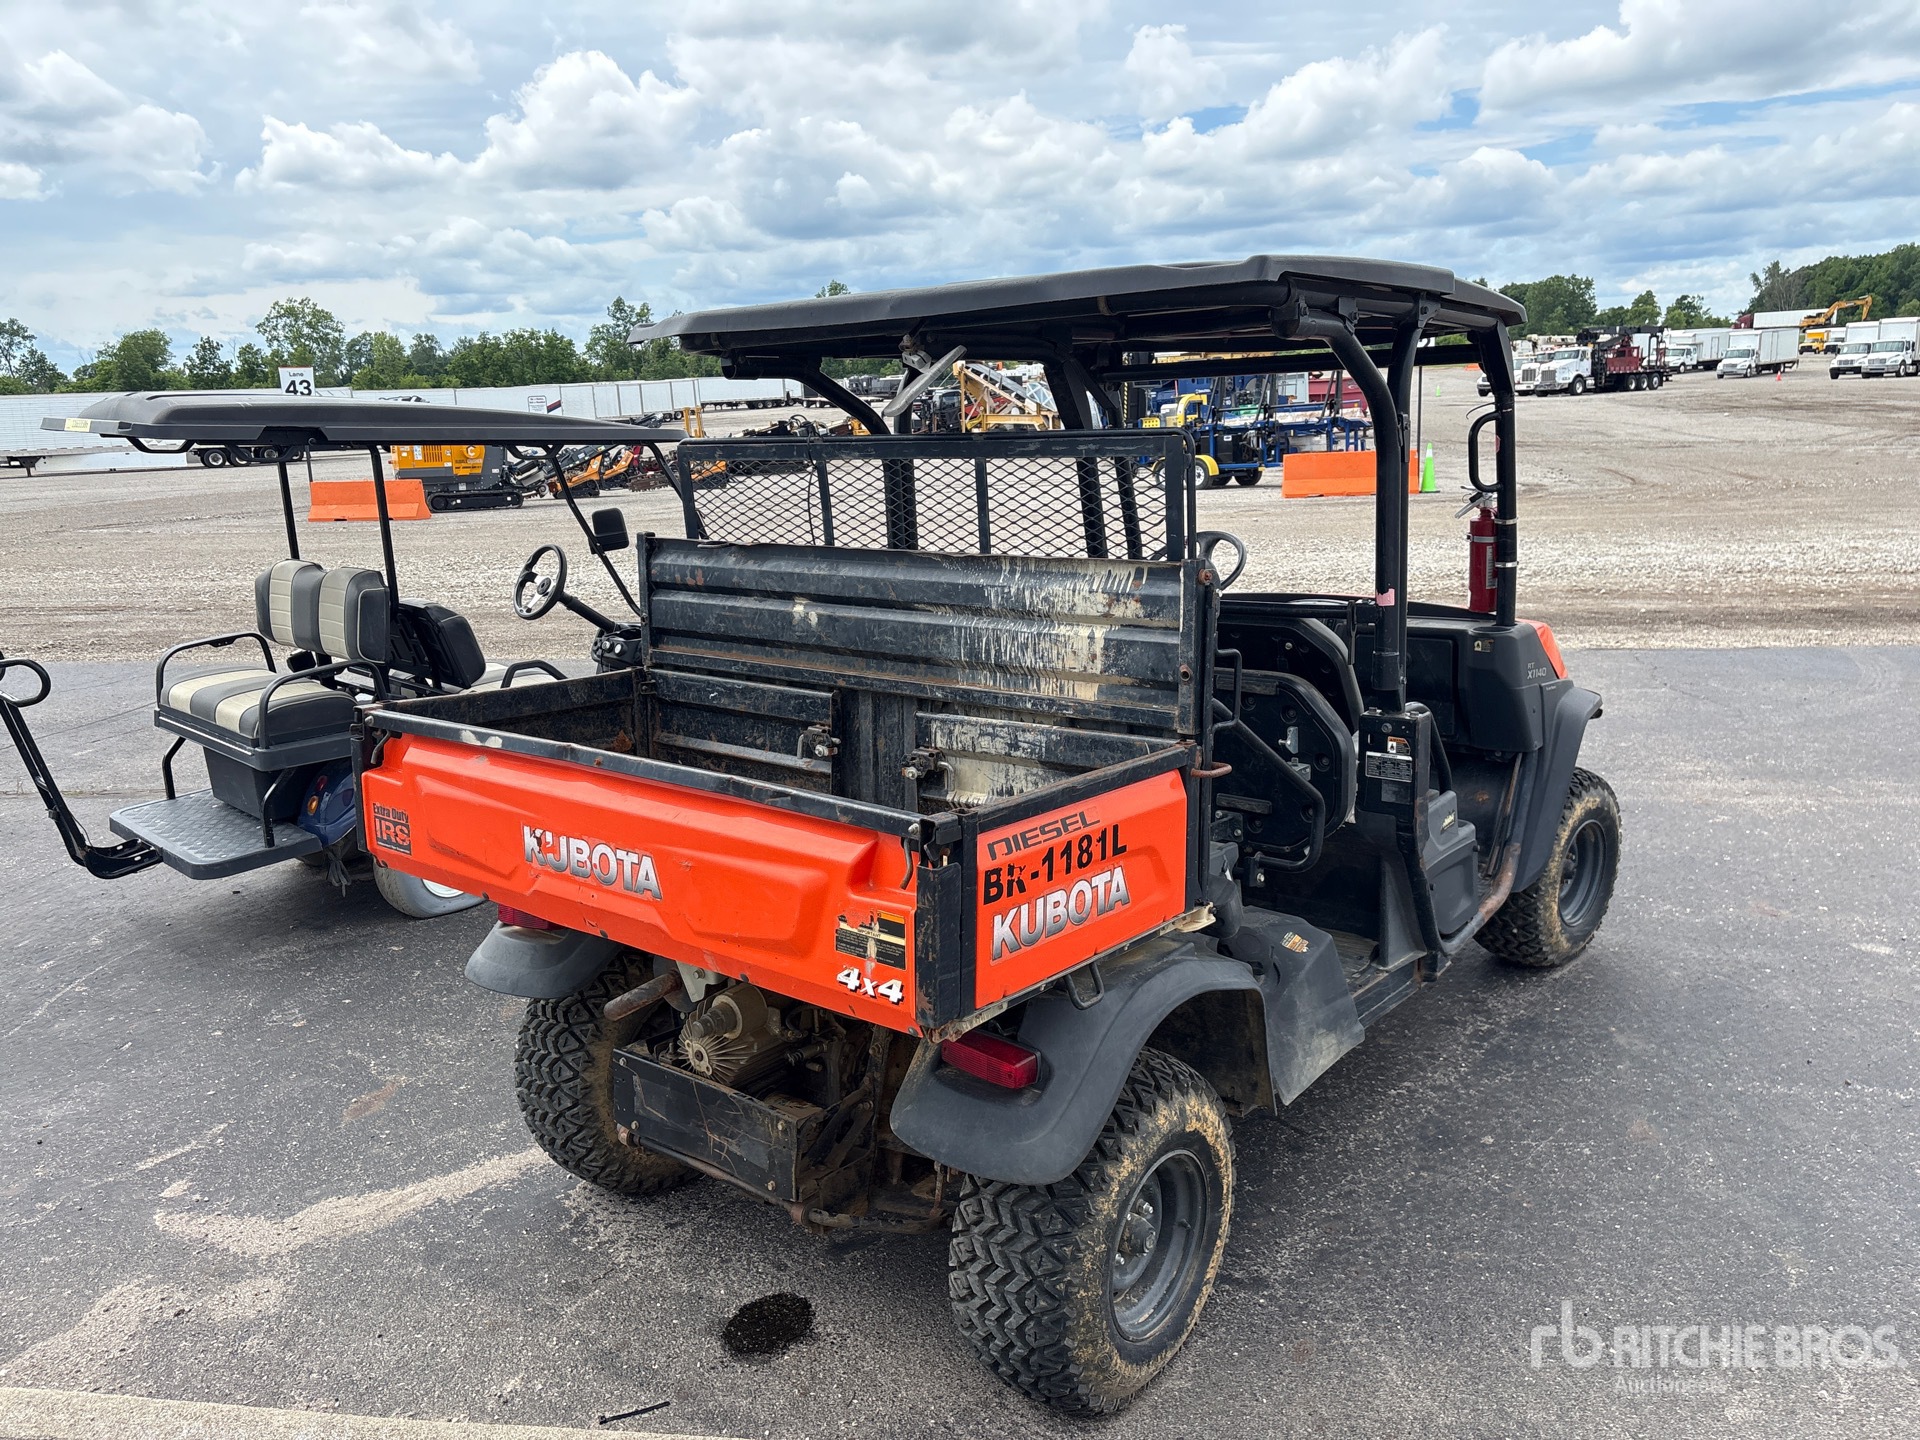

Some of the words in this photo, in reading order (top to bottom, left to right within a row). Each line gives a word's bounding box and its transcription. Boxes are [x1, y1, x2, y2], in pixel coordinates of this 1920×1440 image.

[285, 379, 312, 396] 43
[373, 802, 391, 818] Extra
[391, 808, 409, 823] Duty
[375, 818, 410, 846] IRS
[987, 811, 1100, 861] DIESEL
[523, 824, 663, 900] KUBOTA
[992, 865, 1131, 961] KUBOTA
[836, 967, 904, 1005] 4x4
